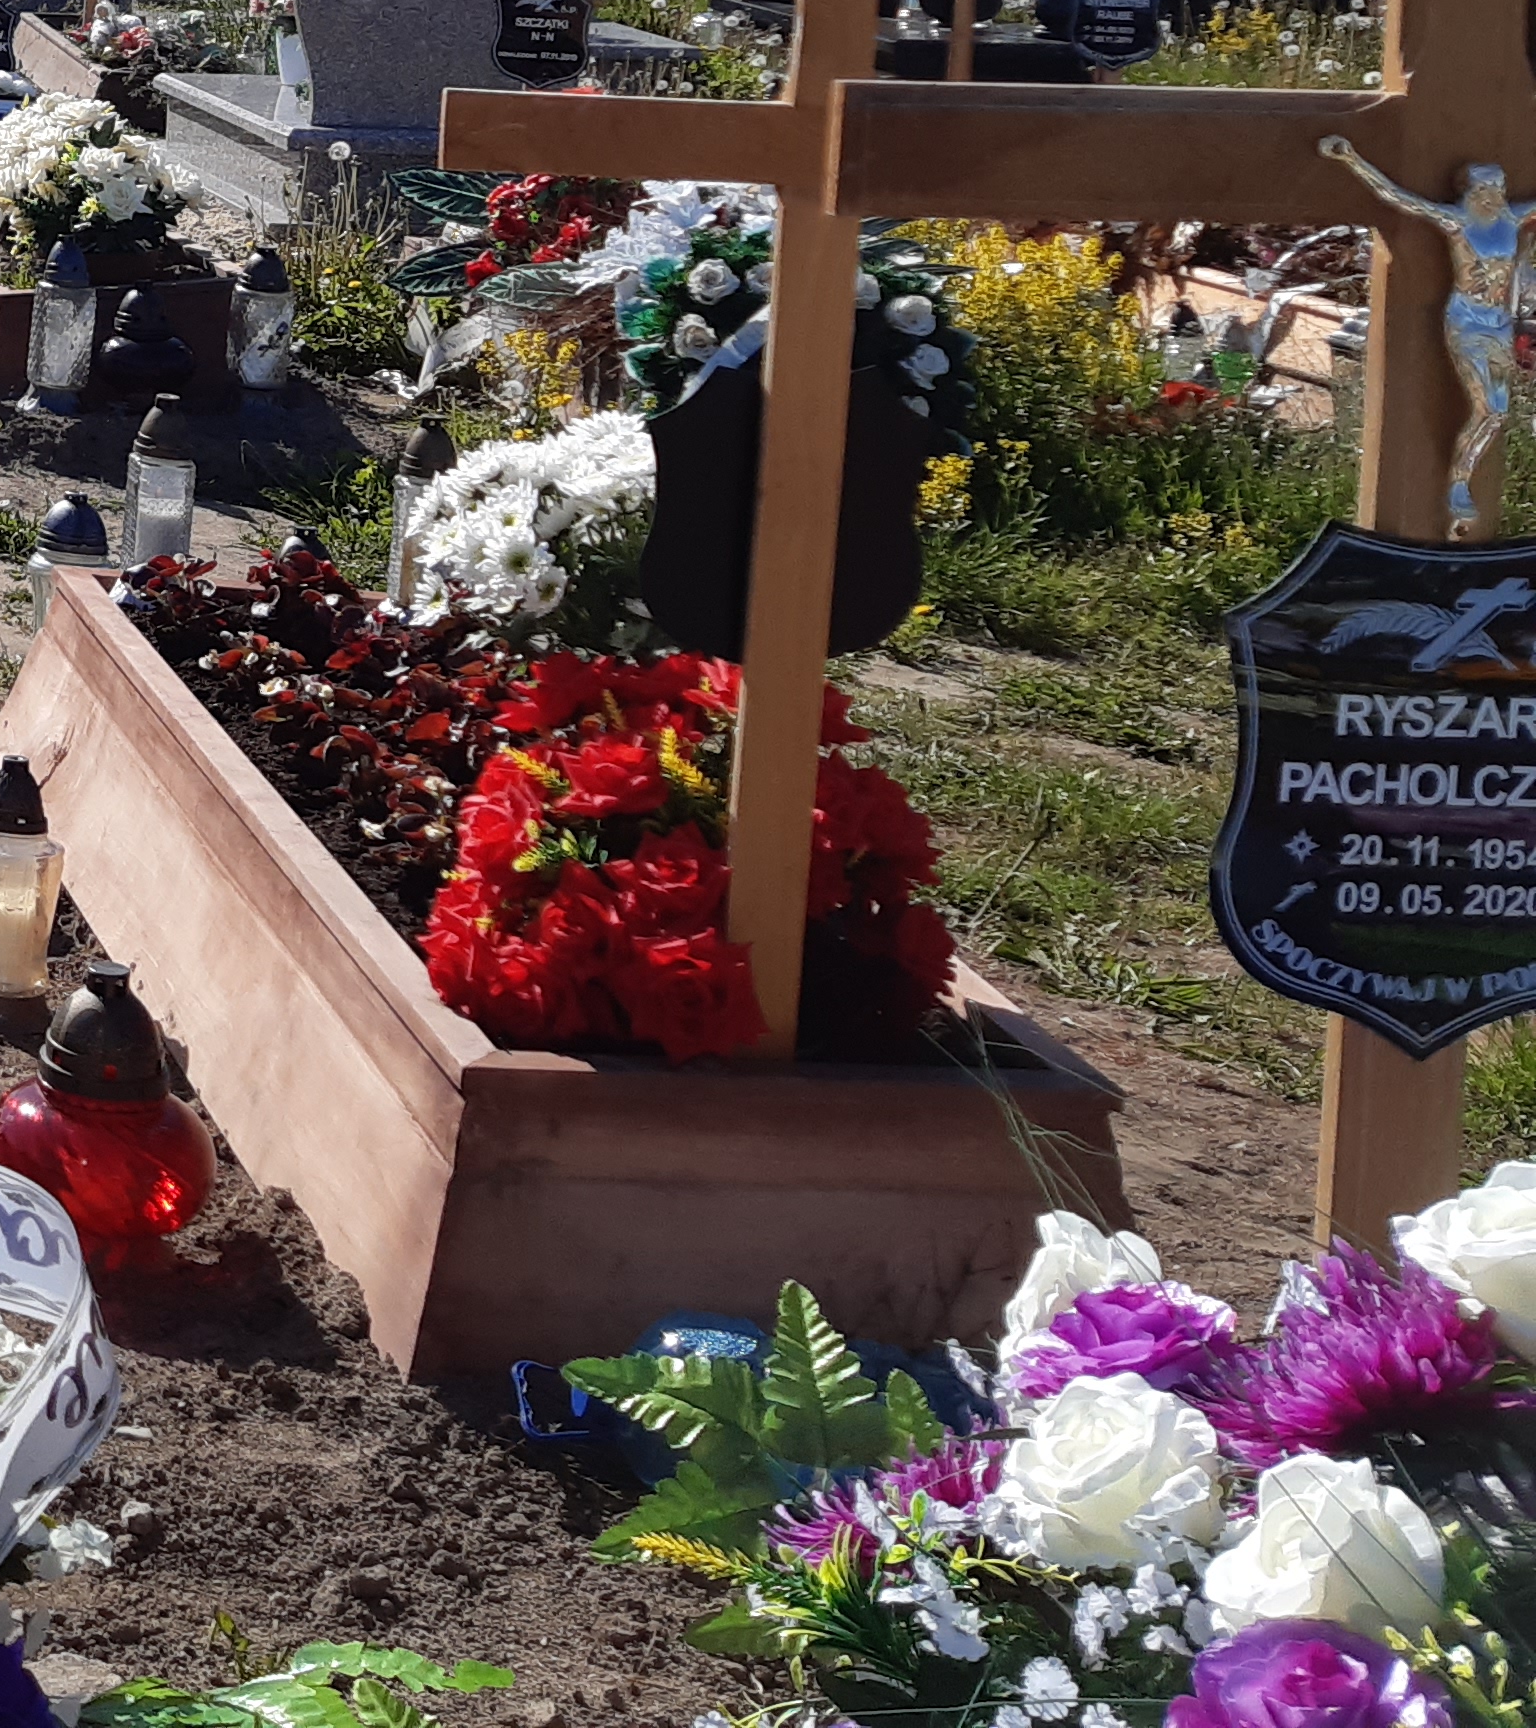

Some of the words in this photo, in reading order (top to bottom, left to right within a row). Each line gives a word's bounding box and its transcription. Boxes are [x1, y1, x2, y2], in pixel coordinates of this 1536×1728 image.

[515, 17, 569, 30] SZCZĄTKI
[1280, 761, 1536, 807] PACHOLCZ
[1251, 919, 1436, 1002] SPOCZYWAJ
[1443, 977, 1474, 1004] W
